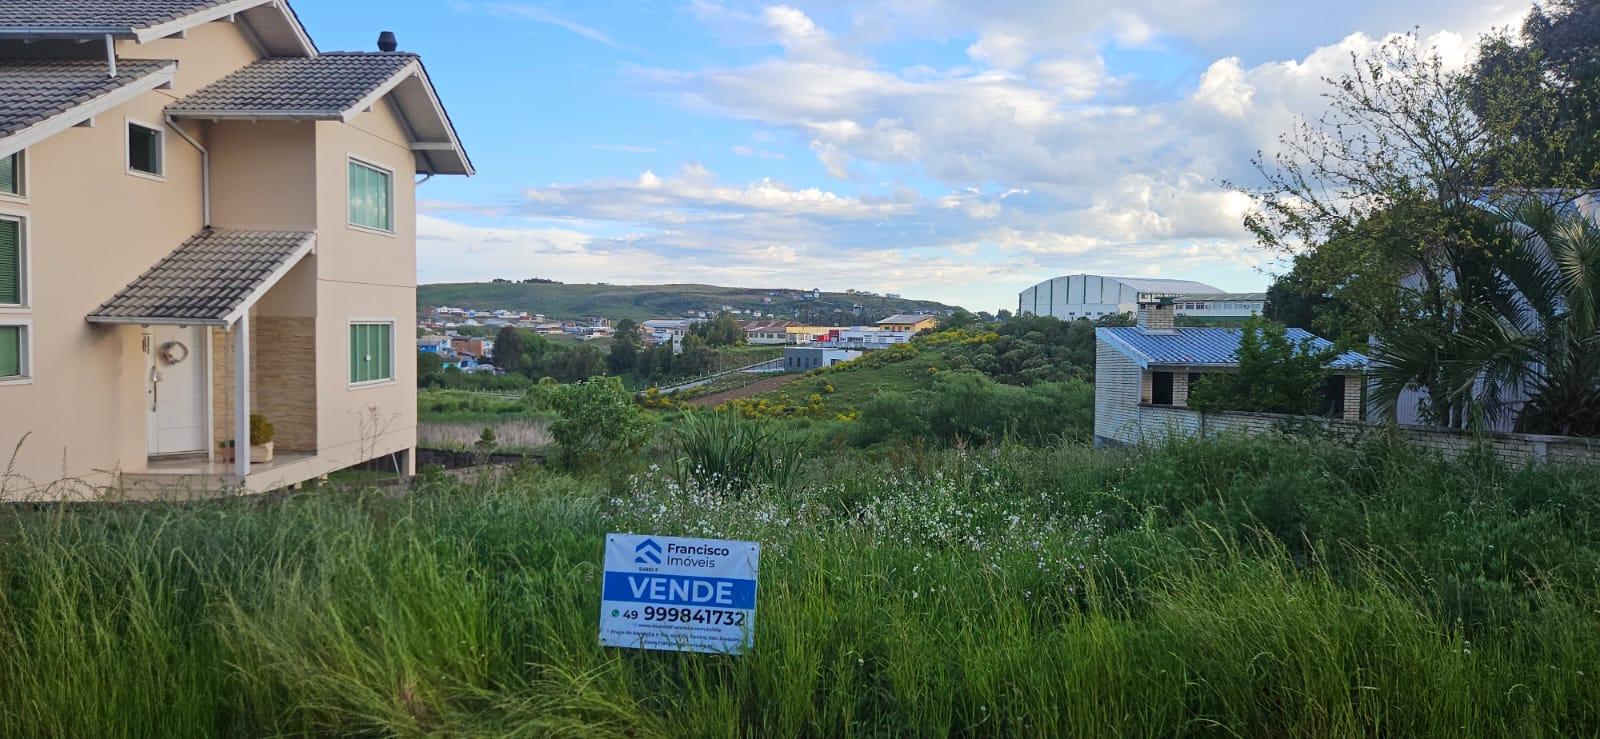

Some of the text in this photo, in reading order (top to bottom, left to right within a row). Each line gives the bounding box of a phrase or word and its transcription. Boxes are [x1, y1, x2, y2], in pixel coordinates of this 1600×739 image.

[667, 543, 730, 557] Francisco
[667, 555, 716, 568] Imóveis
[627, 575, 734, 605] VENDE
[623, 605, 745, 627] 49 999841732
